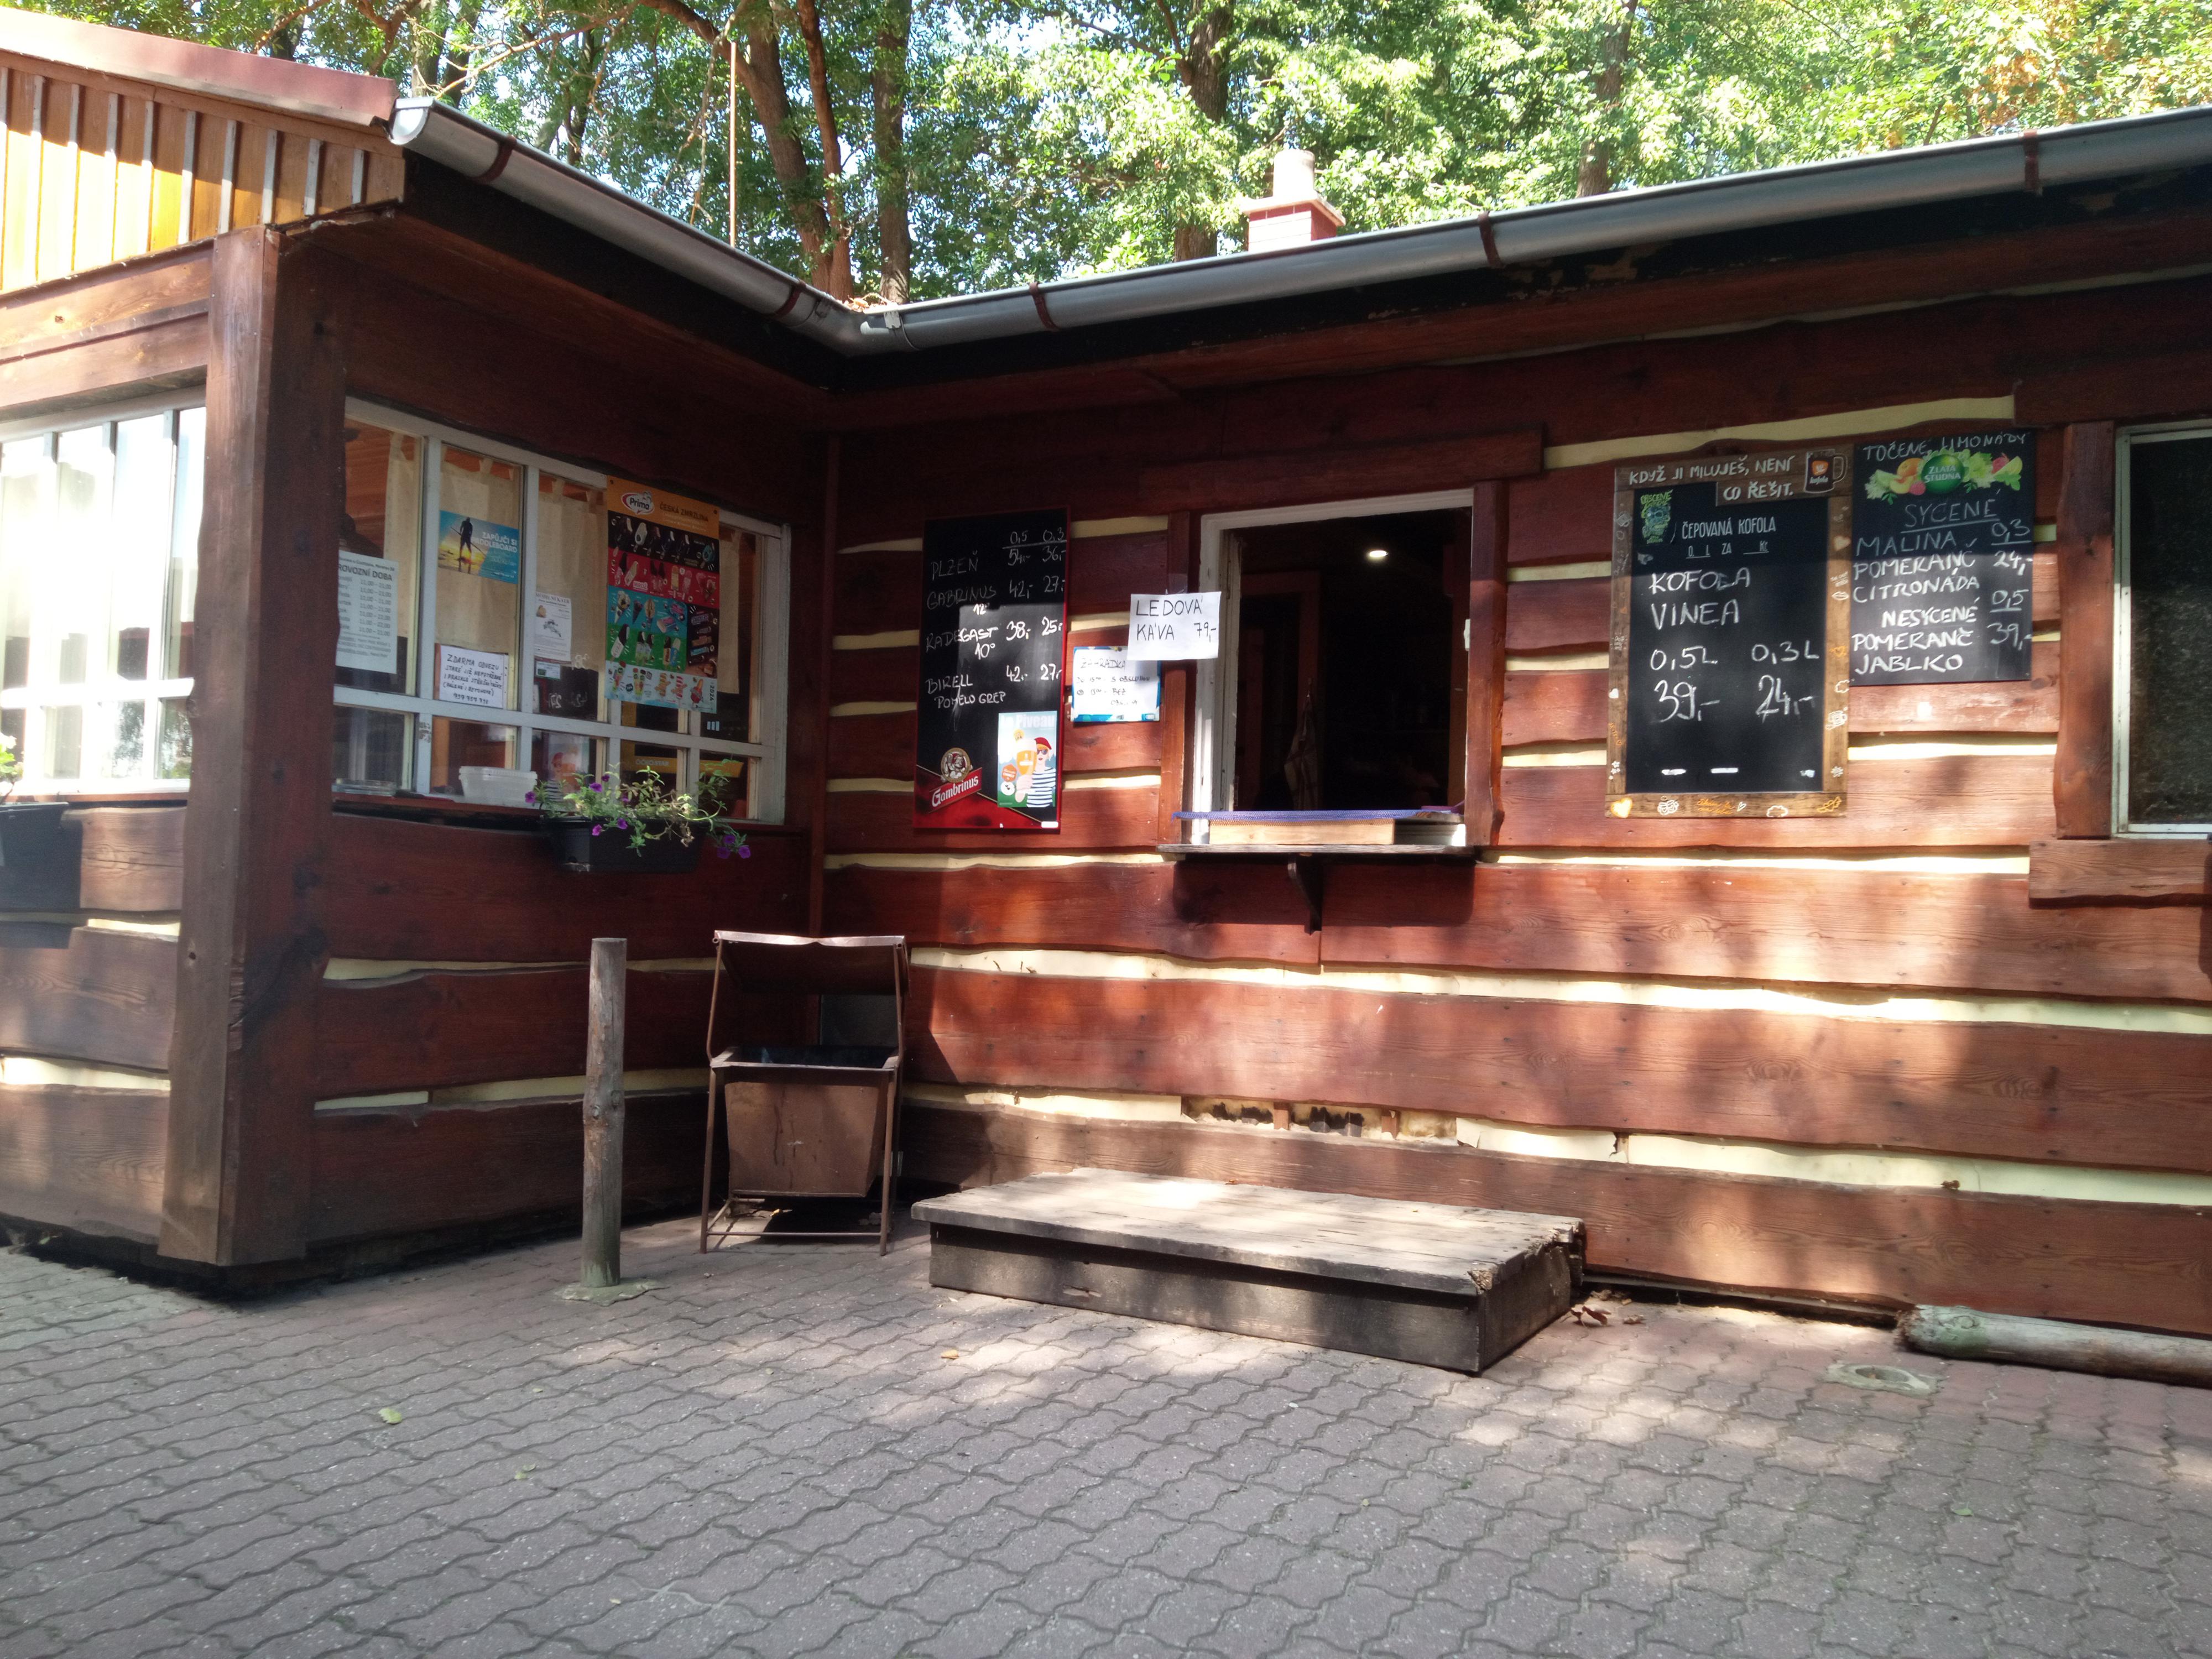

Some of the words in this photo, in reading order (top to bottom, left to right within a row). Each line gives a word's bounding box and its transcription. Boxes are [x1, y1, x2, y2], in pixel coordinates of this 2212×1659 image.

[1942, 432, 2026, 448] LIMONÁDY
[1629, 465, 1666, 485] KDYŽ
[1672, 468, 1683, 480] JI
[1690, 455, 1749, 480] MILUJEŠ,
[1755, 455, 1796, 473] NENÍ
[1723, 486, 1741, 501] CO
[1748, 481, 1794, 498] ŘEŠIT.
[629, 497, 650, 510] Prima
[1010, 530, 1027, 544] 0,5
[1043, 527, 1064, 542] 0,3
[1682, 517, 1733, 540] ČEPOVANÁ
[1738, 517, 1776, 535] KOFOLA
[1991, 519, 2031, 543] 0,3
[1721, 543, 1732, 555] ZA
[1856, 530, 1957, 556] MALINA
[338, 564, 371, 576] ROVOZNÍ
[372, 570, 393, 581] DOBA
[1993, 550, 2033, 576] 24,-
[1853, 567, 1980, 603] CITRONÁDA
[1136, 595, 1203, 616] LEDOVÁ
[1992, 589, 2029, 608] 0,5
[1651, 598, 1739, 630] VINEA
[1881, 597, 1980, 628] NESYCENÉ
[926, 626, 999, 653] RADEGAST
[1137, 622, 1175, 641] KÁVA
[1193, 622, 1217, 643] 79,-
[1851, 627, 1974, 651] POMERANČ
[1986, 622, 2032, 650] 39,-
[447, 654, 474, 666] ZDARMA
[1854, 654, 1963, 675] JABLKO
[926, 674, 973, 695] BIRELL
[978, 691, 1006, 704] GREP
[1653, 680, 1720, 723] 39,-
[931, 775, 979, 807] Gambrinus
